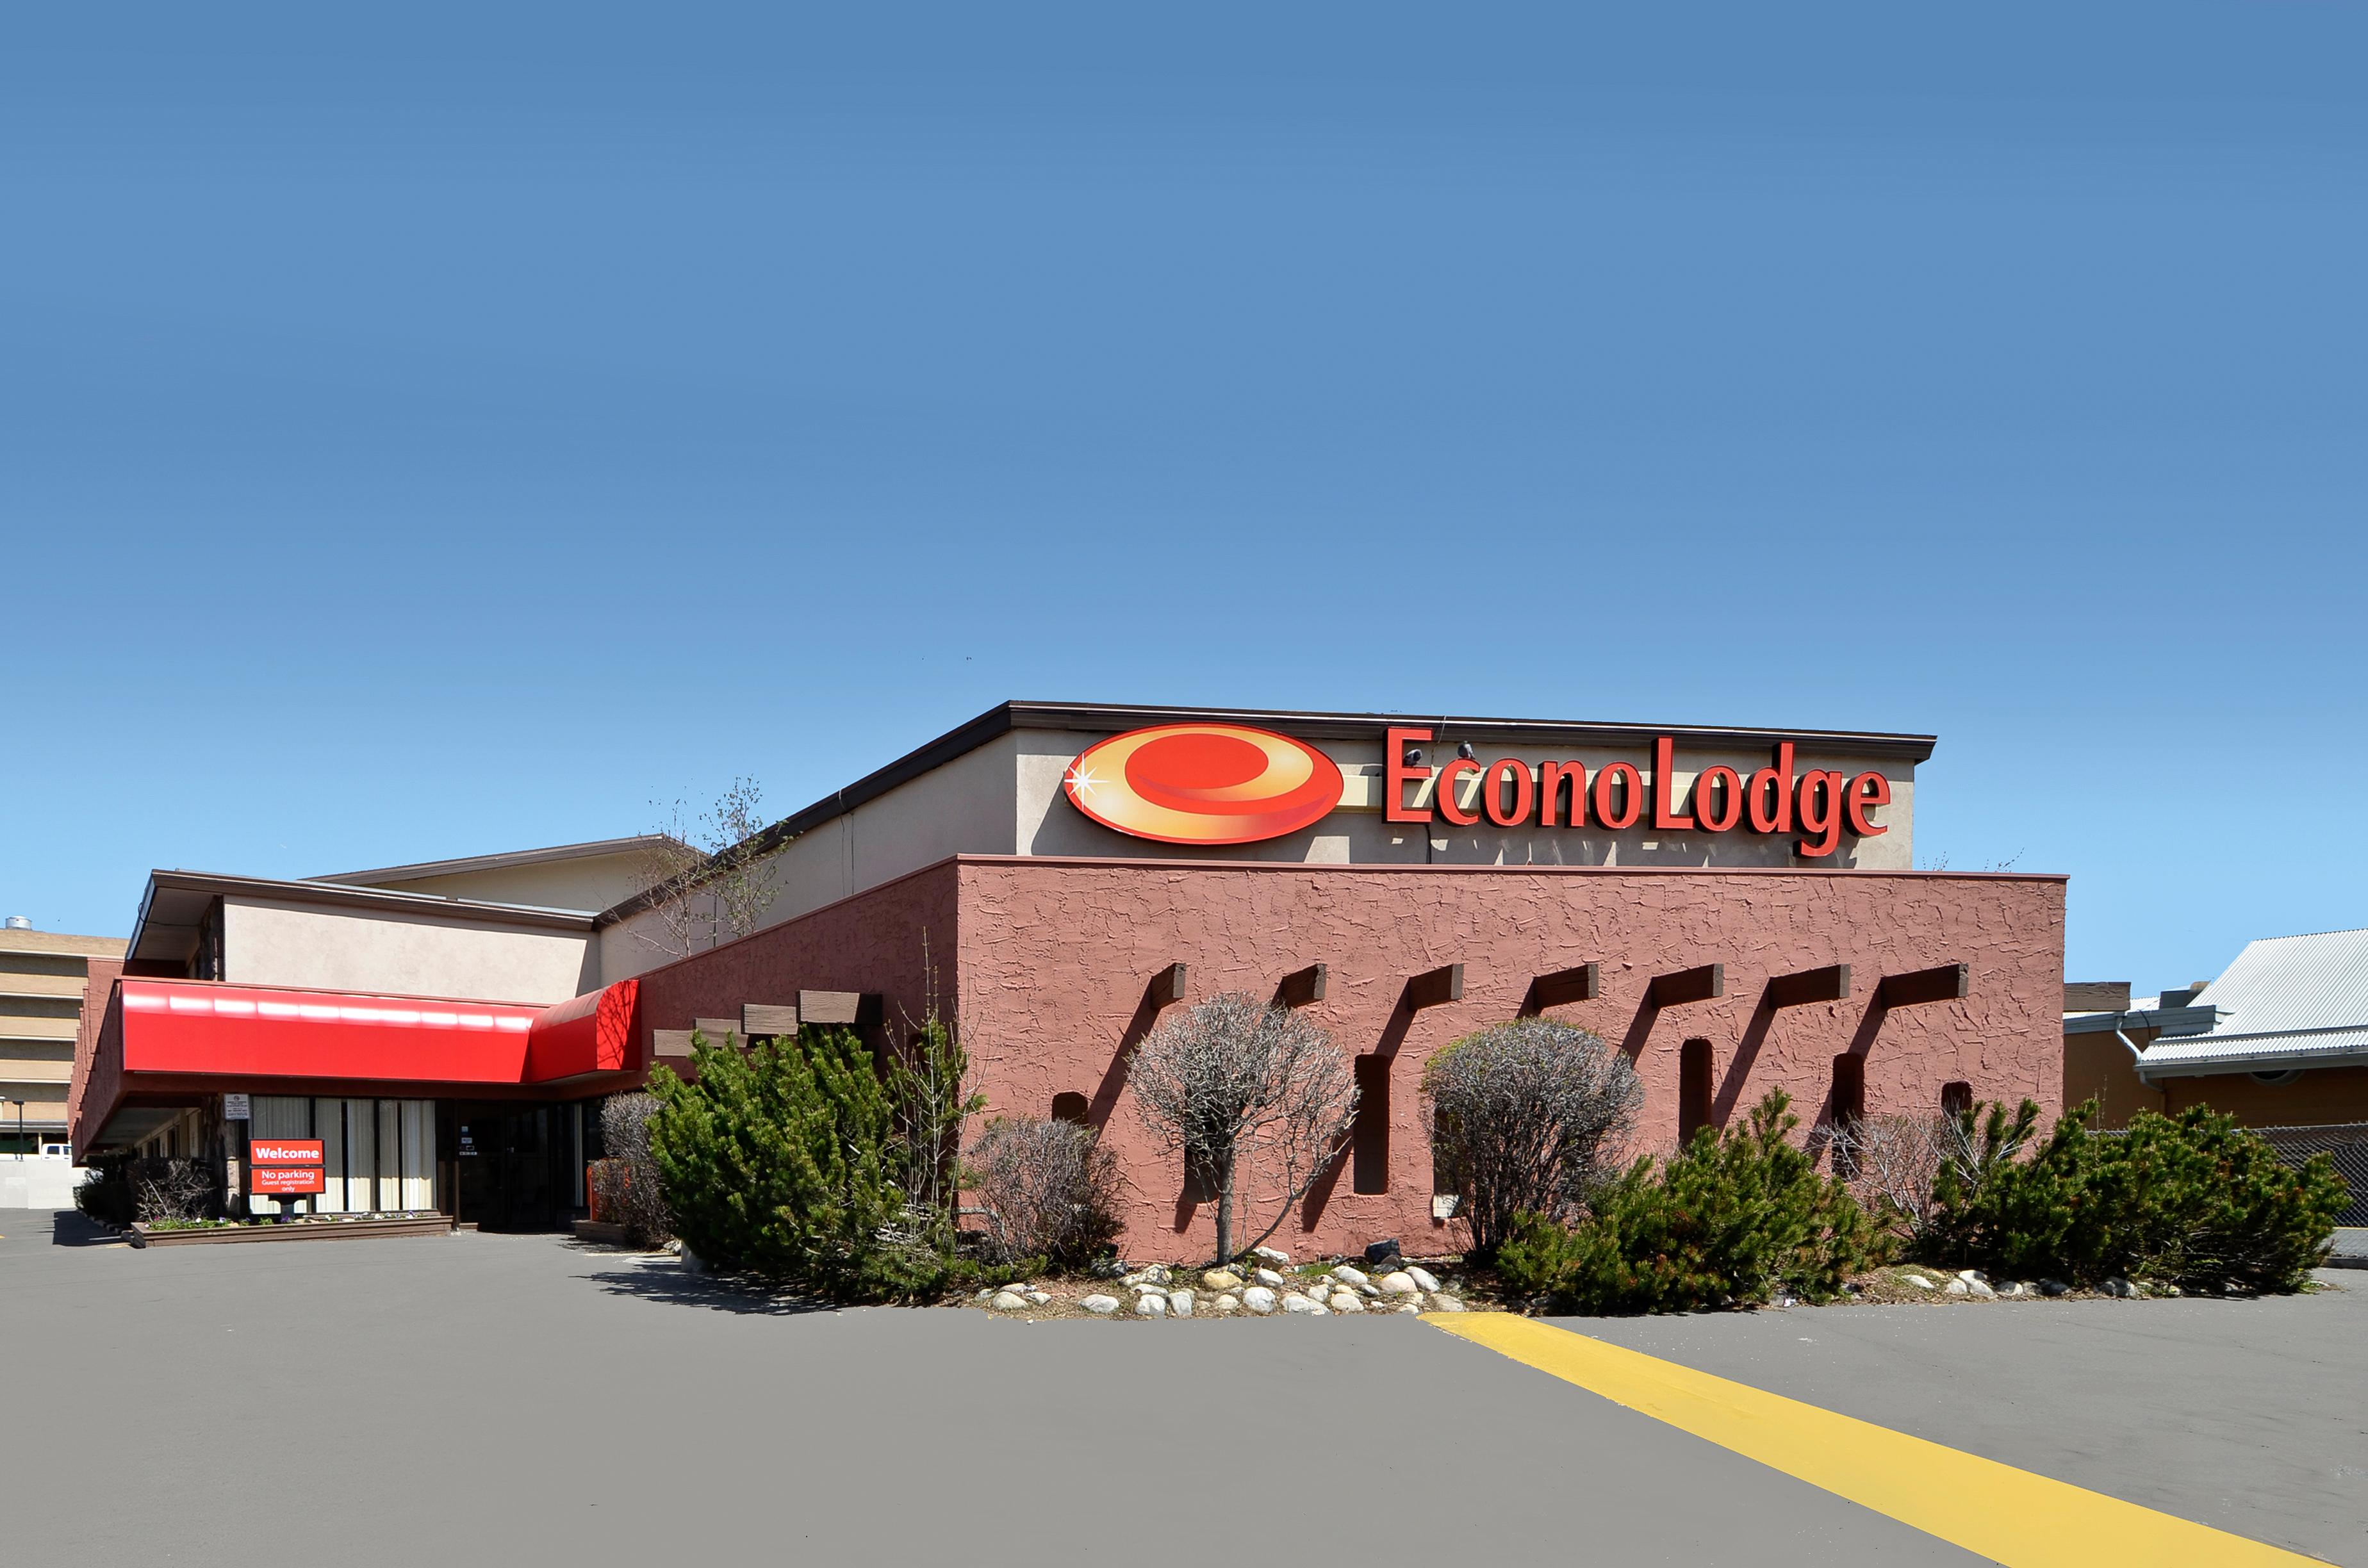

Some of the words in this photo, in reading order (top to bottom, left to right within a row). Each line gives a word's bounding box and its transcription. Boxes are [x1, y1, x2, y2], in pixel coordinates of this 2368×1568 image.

[256, 1147, 319, 1159] Welcome
[261, 1171, 276, 1179] No
[278, 1170, 315, 1180] parking
